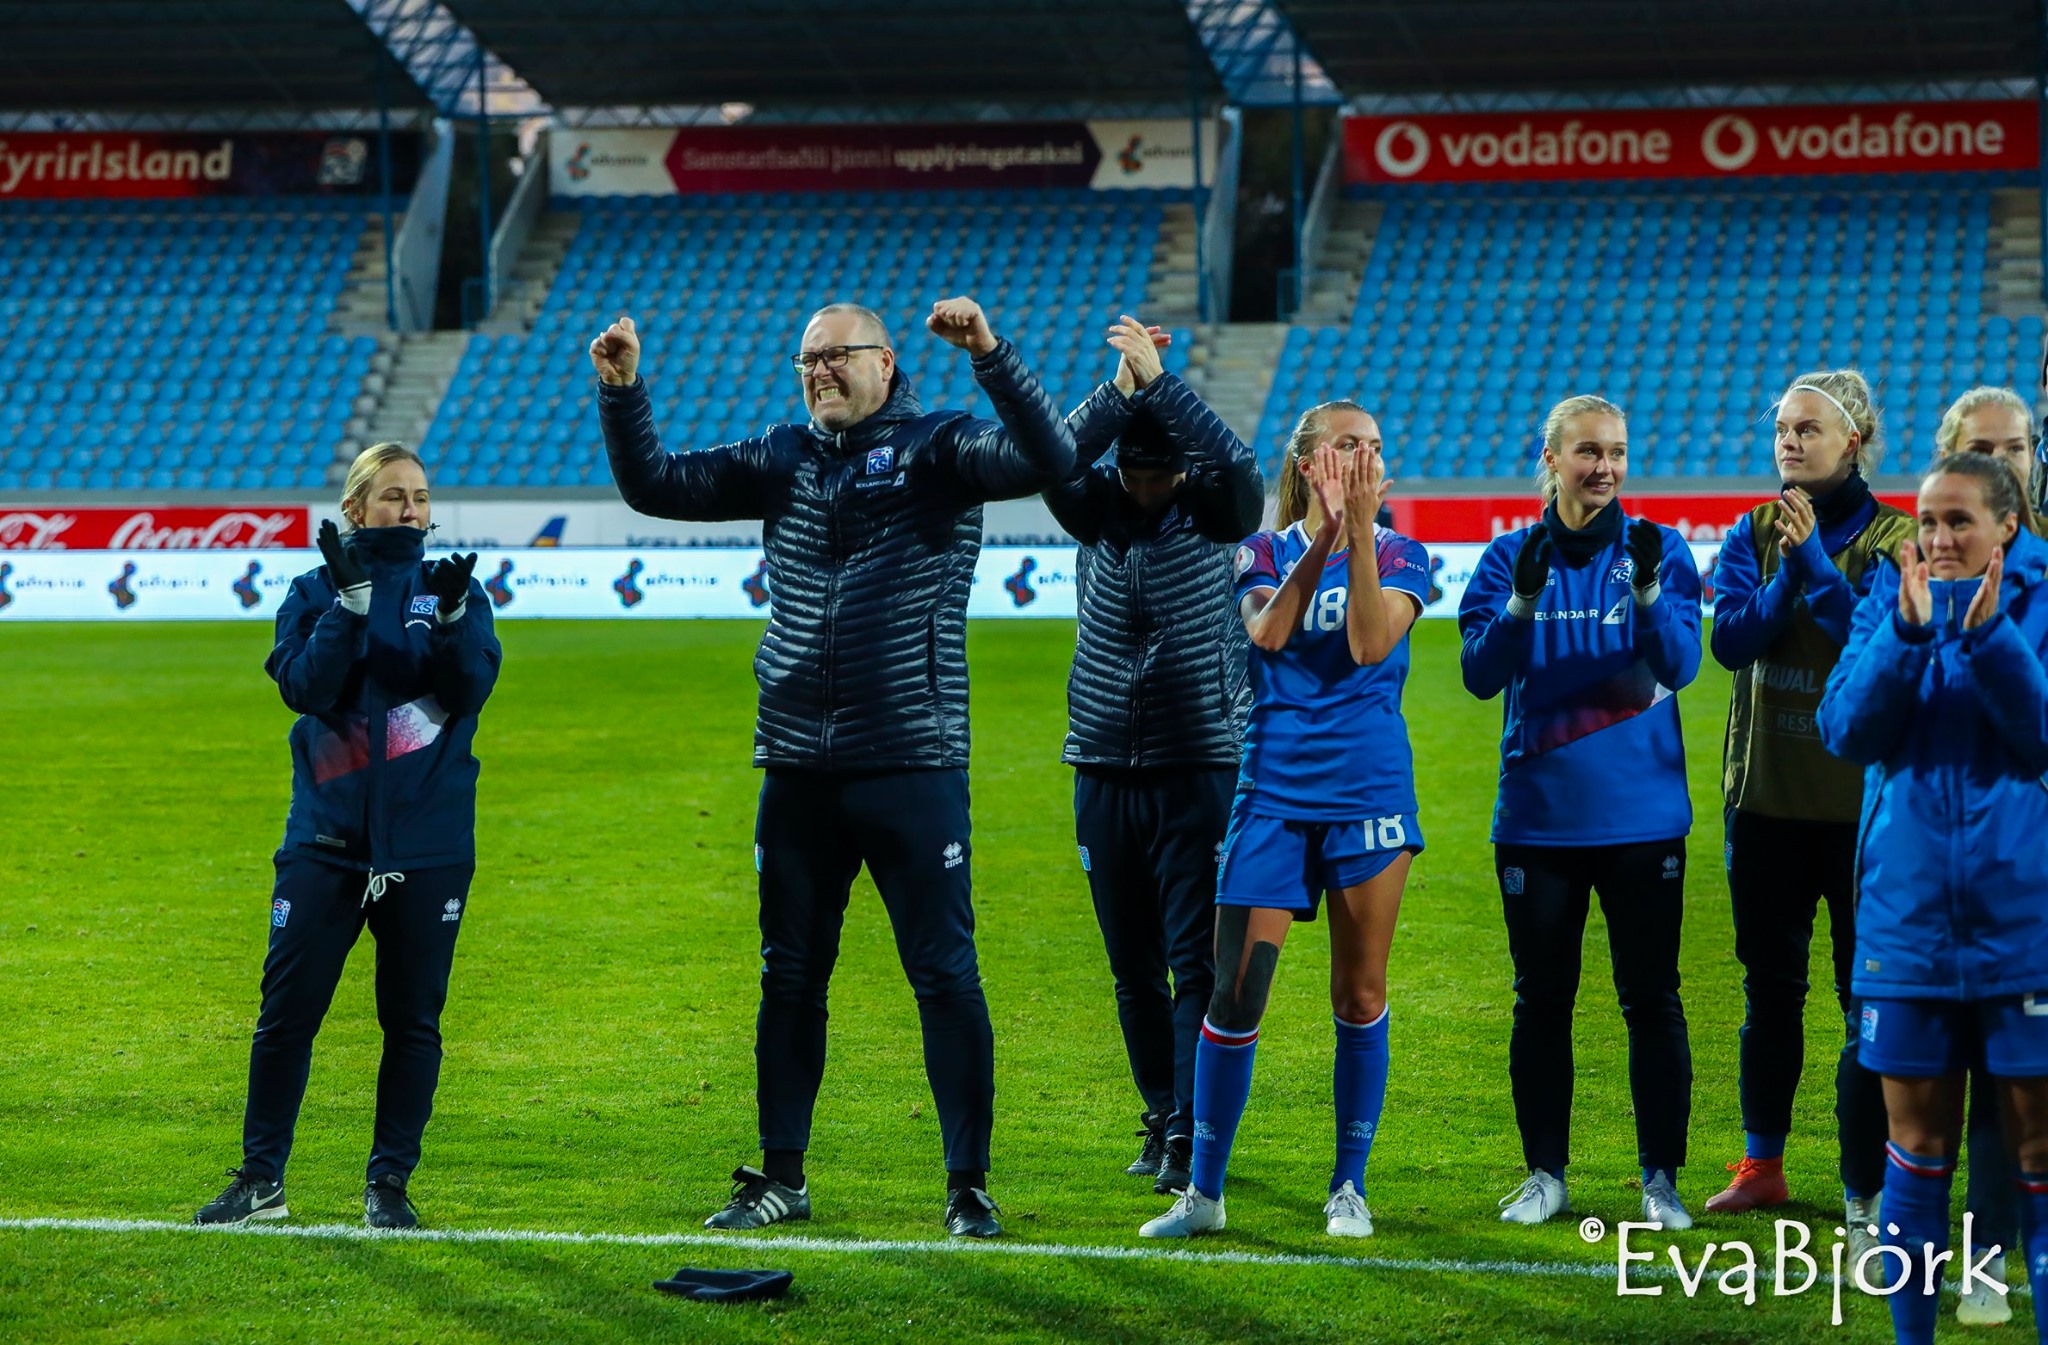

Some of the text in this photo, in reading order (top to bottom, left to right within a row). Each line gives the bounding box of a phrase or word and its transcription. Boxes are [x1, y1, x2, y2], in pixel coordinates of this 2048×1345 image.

[1440, 120, 1672, 167] vodafone
[1769, 113, 2004, 162] vodafone
[1303, 586, 1348, 632] 18
[1535, 608, 1598, 621] ELANDAIR
[1363, 814, 1406, 850] 18
